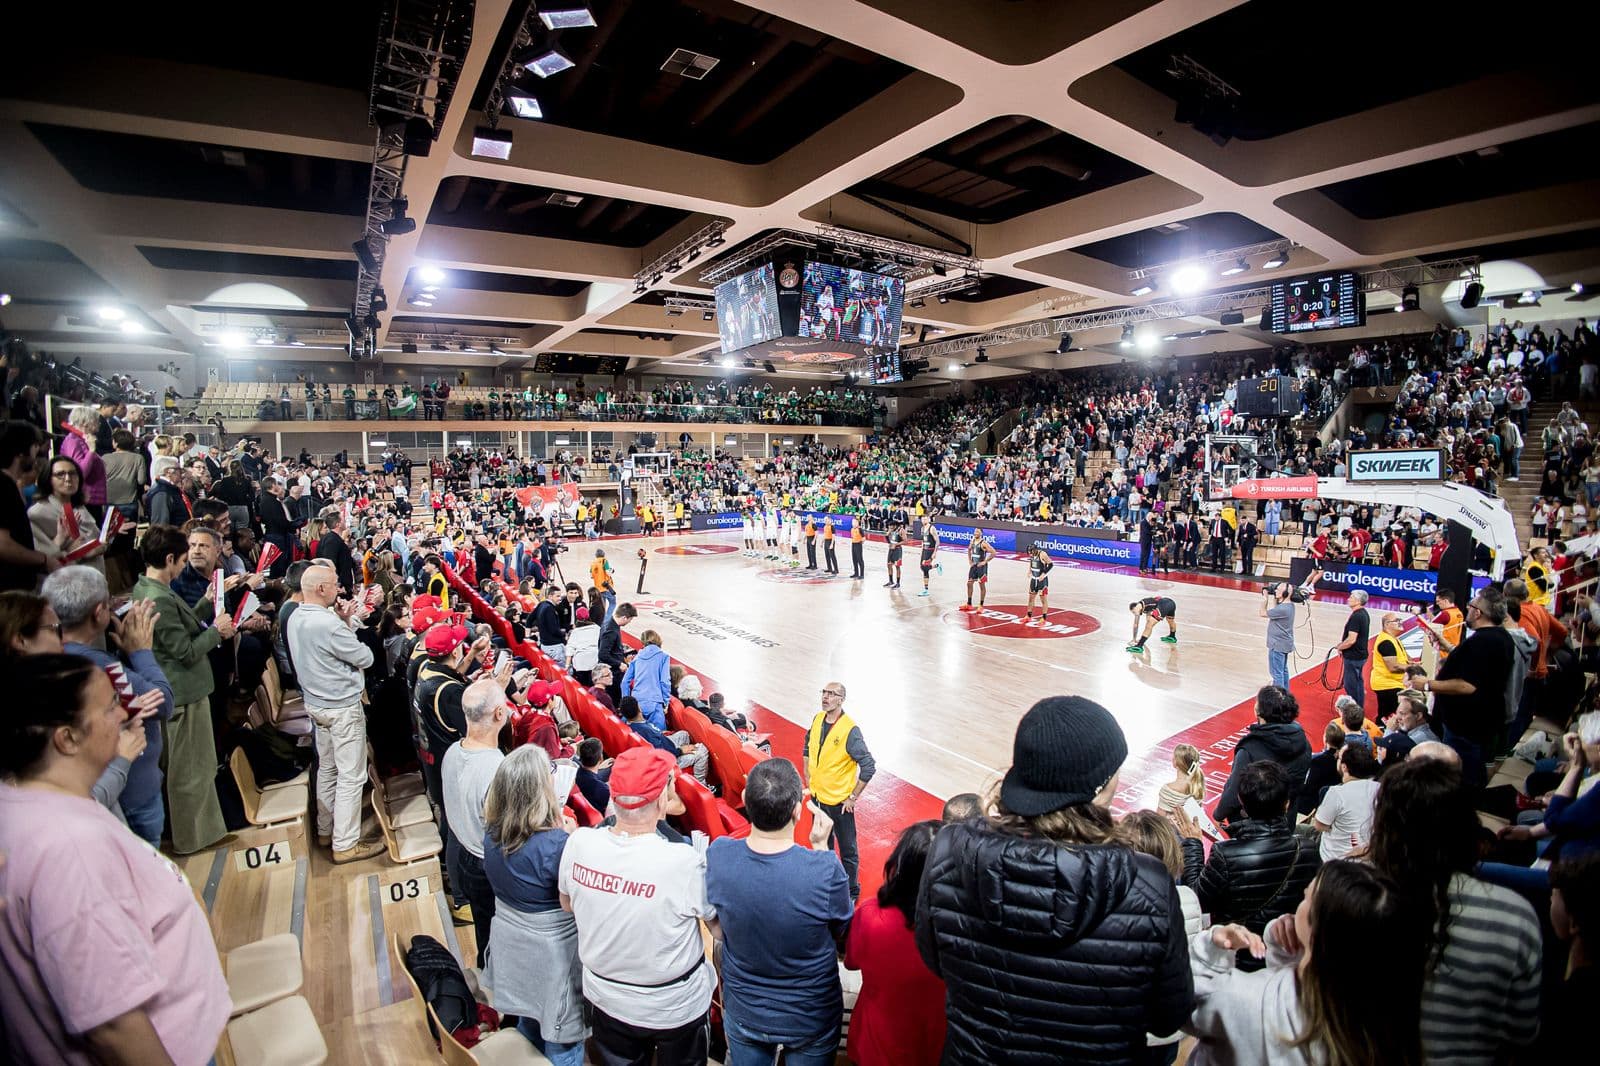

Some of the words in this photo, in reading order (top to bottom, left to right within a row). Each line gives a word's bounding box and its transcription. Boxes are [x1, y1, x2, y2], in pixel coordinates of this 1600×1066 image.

[1294, 287, 1301, 296] 0
[1323, 283, 1330, 292] 0
[1303, 301, 1323, 311] 0:20
[1260, 379, 1277, 392] 20
[1356, 458, 1435, 473] SKWEEK
[1458, 506, 1489, 530] SPALDING
[1034, 539, 1131, 559] euroleaguestore.net
[1322, 569, 1437, 593] euroleaguesto
[653, 610, 728, 641] EuroLeague
[677, 608, 722, 629] TURKISH
[720, 625, 780, 649] AIRLINES
[245, 843, 281, 869] 04
[390, 879, 420, 902] 03
[573, 864, 621, 891] MONACO
[622, 881, 656, 899] INFO
